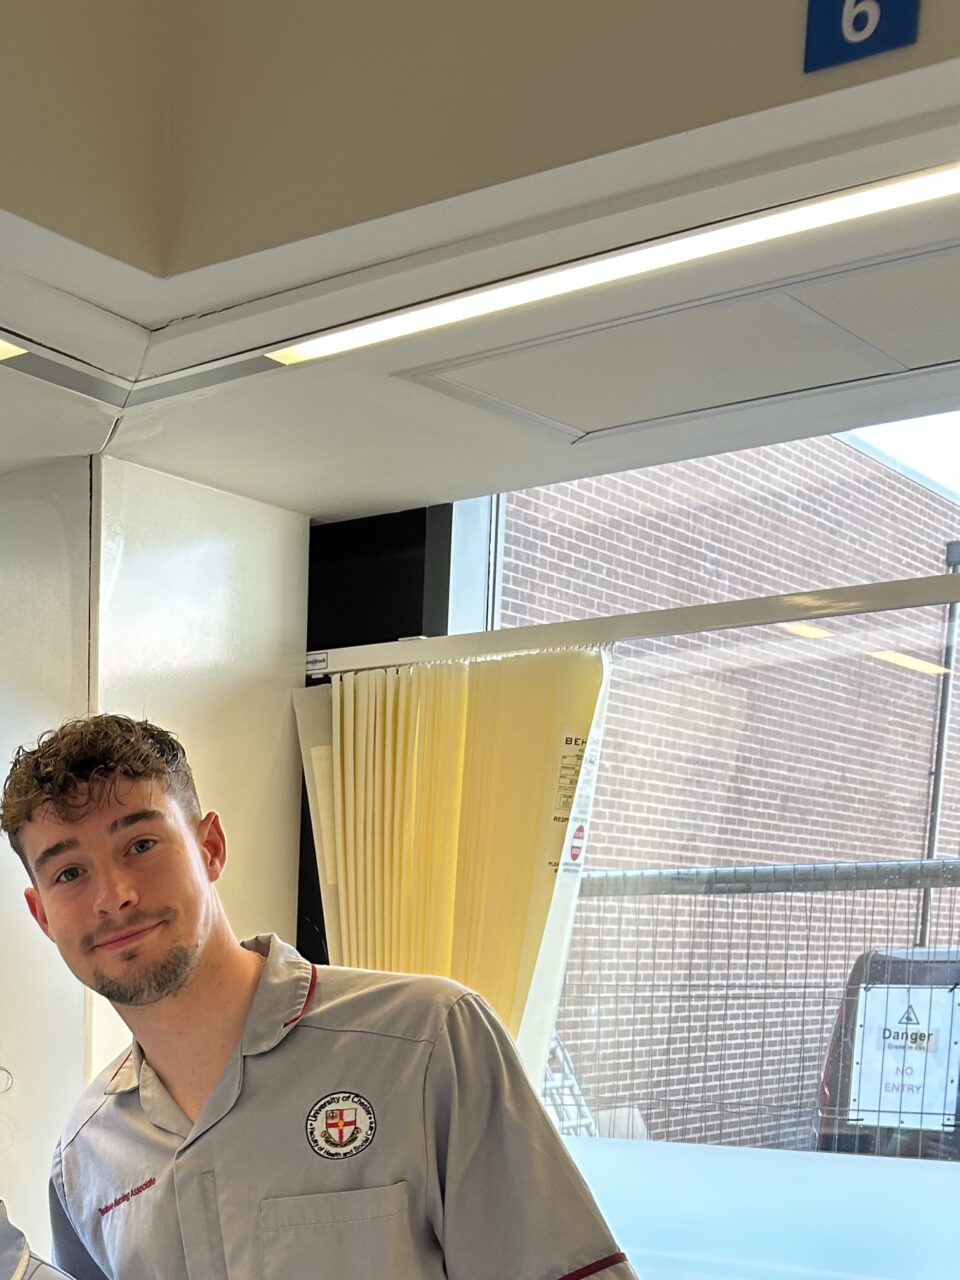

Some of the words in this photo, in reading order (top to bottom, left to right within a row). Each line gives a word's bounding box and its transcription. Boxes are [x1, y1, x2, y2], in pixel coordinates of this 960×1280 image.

[842, 0, 881, 43] 6
[882, 1028, 934, 1044] Danger
[895, 1066, 914, 1076] NO
[884, 1082, 922, 1094] ENTRY
[308, 1096, 340, 1122] University
[341, 1094, 352, 1102] of
[351, 1094, 373, 1116] Chester
[130, 1176, 156, 1198] Associate
